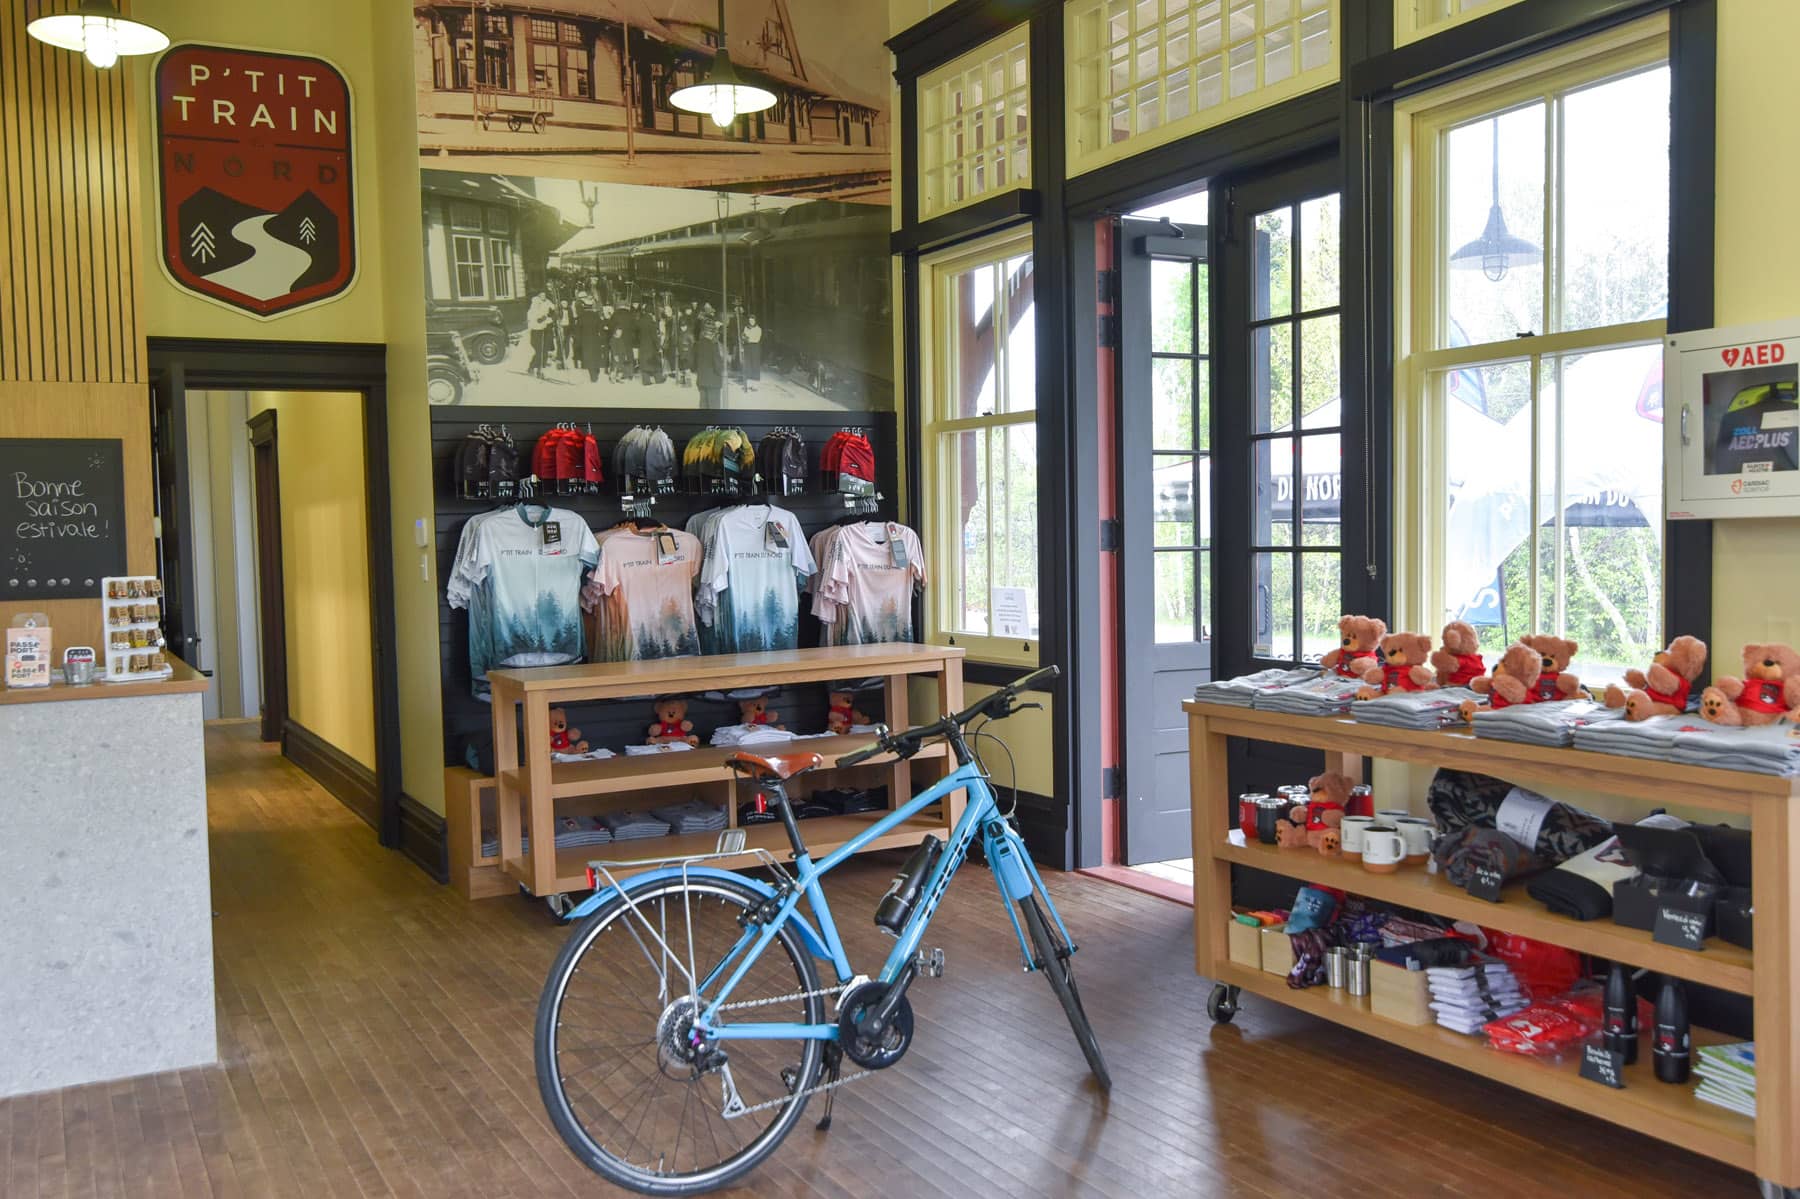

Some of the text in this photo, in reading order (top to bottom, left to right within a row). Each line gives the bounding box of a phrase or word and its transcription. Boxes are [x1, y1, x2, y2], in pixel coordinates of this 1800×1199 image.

[190, 64, 317, 98] P'TIT
[172, 95, 338, 135] TRAIN
[173, 152, 338, 185] NORD
[1741, 343, 1785, 368] AED
[15, 471, 85, 498] Bonne
[916, 828, 971, 921] TREK
